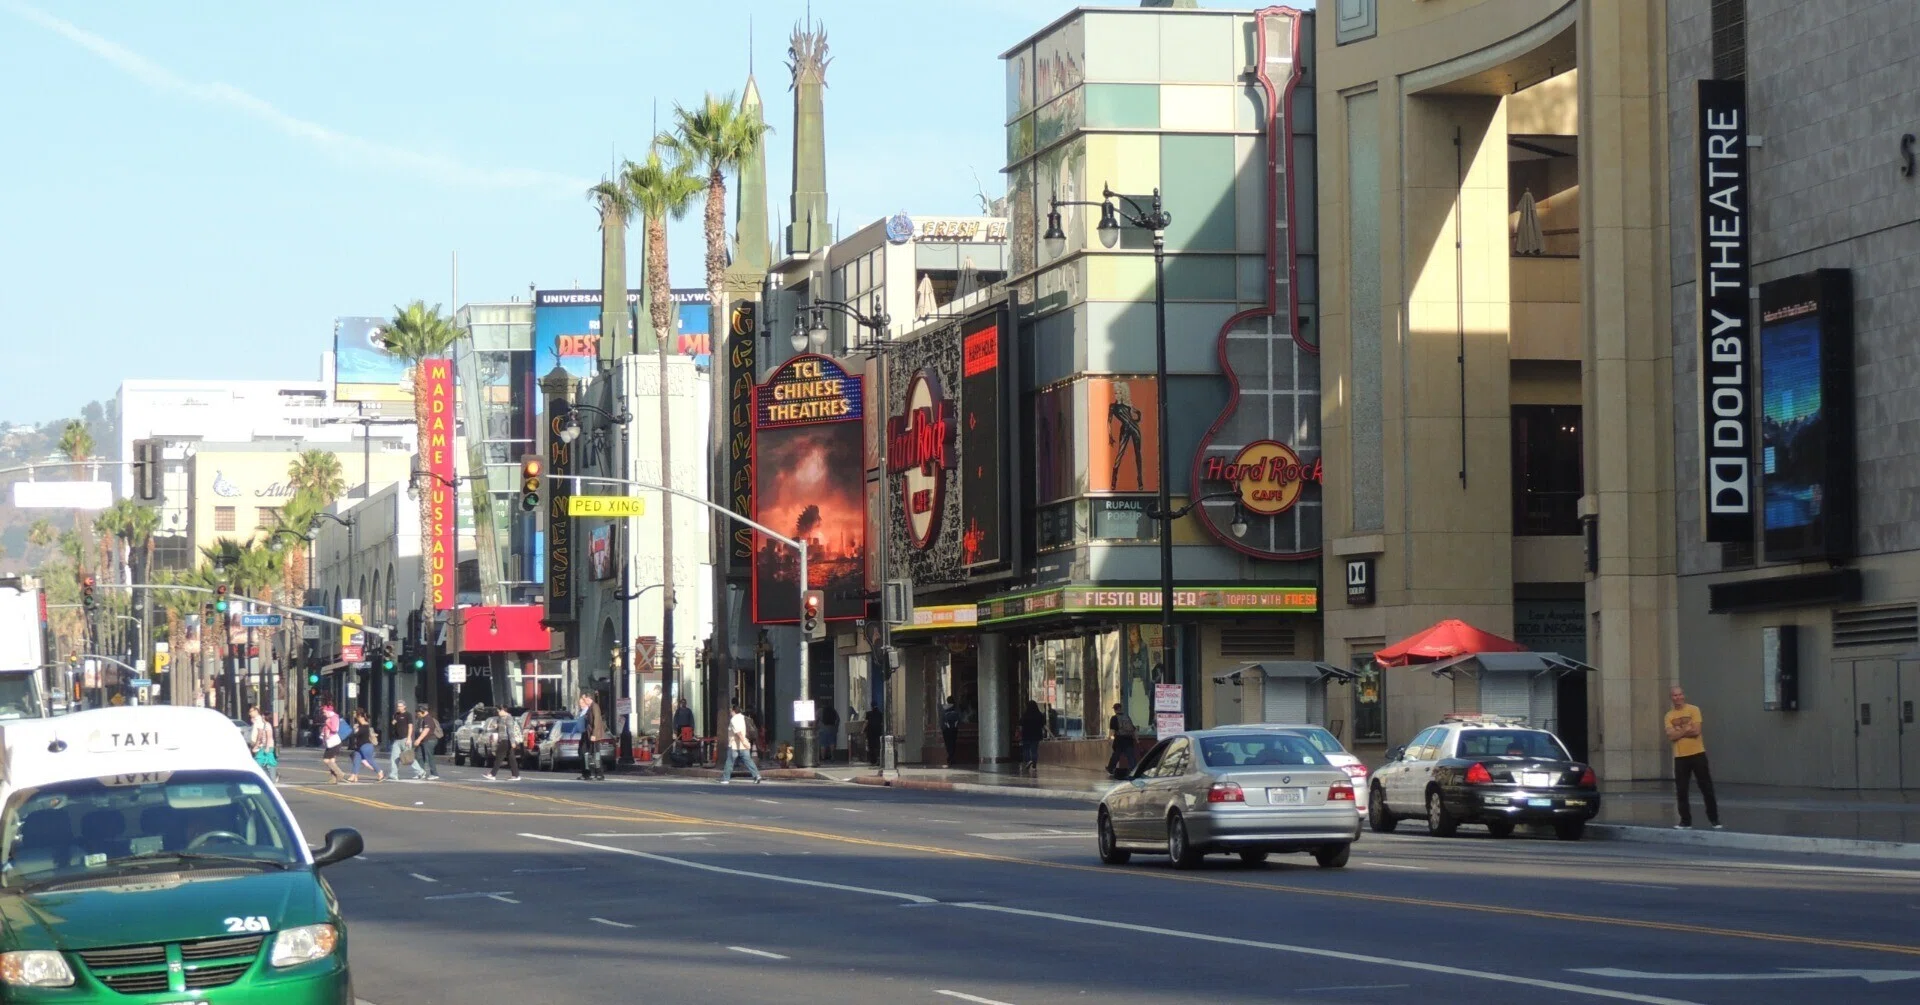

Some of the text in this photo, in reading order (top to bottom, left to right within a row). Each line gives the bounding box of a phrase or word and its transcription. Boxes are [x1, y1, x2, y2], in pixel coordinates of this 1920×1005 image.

[922, 221, 980, 237] FRESH
[1707, 108, 1744, 448] DOLBY THEATRE
[669, 293, 711, 302] OLLYWO
[793, 361, 822, 378] TCL
[774, 379, 843, 400] CHINESE
[768, 399, 850, 421] THEATRES
[887, 402, 946, 476] Hard Rock
[1208, 455, 1322, 487] Hard Rock
[432, 366, 446, 603] MADAME TUSSAUDS
[1251, 489, 1283, 501] CAFE
[552, 415, 569, 598] CHINESE
[575, 500, 639, 512] PED XING
[1105, 501, 1143, 510] RUPAUL
[1107, 512, 1142, 521] POP-UP
[1085, 592, 1135, 606] FIESTA
[1139, 592, 1197, 606] BUER
[1226, 594, 1257, 605] TOPPED
[1260, 594, 1281, 605] WITH
[245, 616, 268, 625] Orange
[111, 732, 159, 747] TAXI
[223, 915, 271, 932] 261
